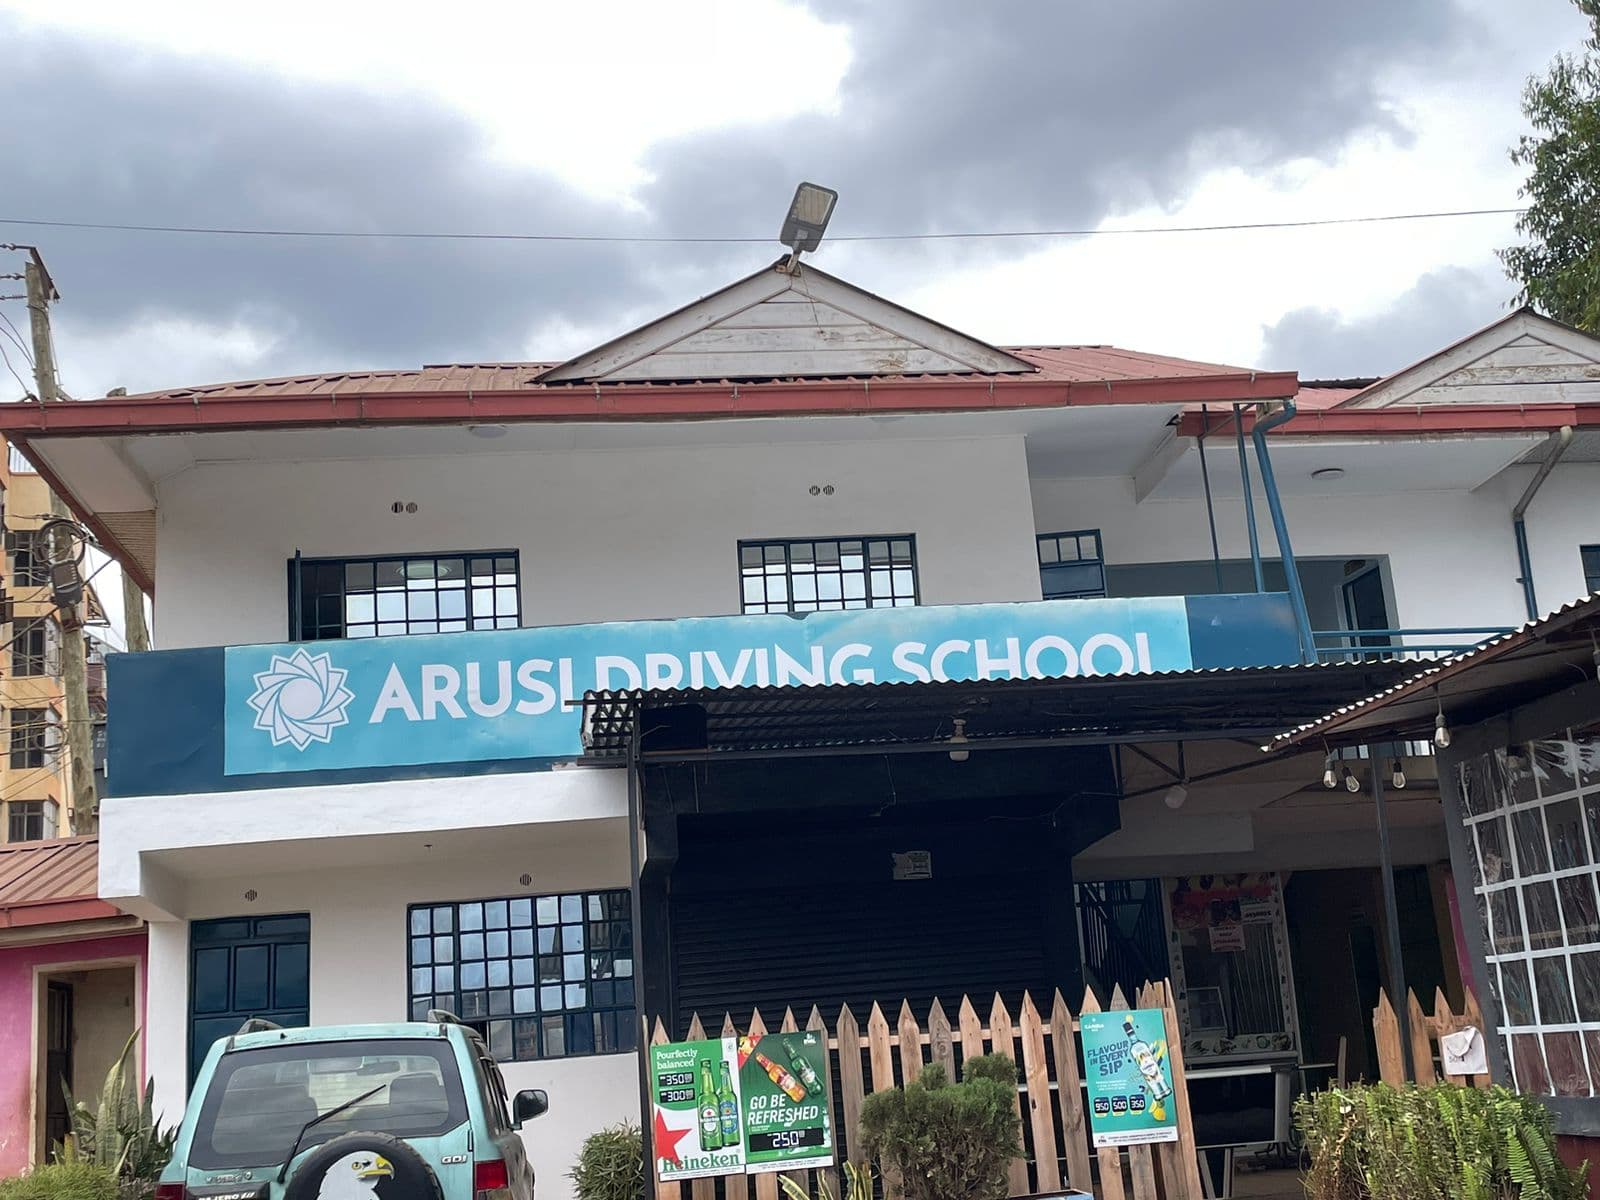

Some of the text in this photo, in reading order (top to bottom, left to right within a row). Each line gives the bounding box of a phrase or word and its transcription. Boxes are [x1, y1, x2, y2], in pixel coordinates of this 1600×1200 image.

[368, 657, 575, 724] ARUSI
[595, 643, 875, 691] DRIVING
[656, 1048, 698, 1060] Pourfectly
[1087, 1040, 1129, 1058] FLAVOUR
[1090, 1049, 1129, 1066] IN EVERY
[657, 1058, 695, 1070] balanced
[1100, 1060, 1123, 1076] SIP
[666, 1073, 685, 1085] 350
[667, 1090, 686, 1102] 300
[749, 1093, 787, 1110] GO BE
[747, 1105, 819, 1126] REFRESHED
[772, 1130, 800, 1148] 250
[441, 1155, 468, 1164] GDI
[663, 1153, 740, 1173] Heineken
